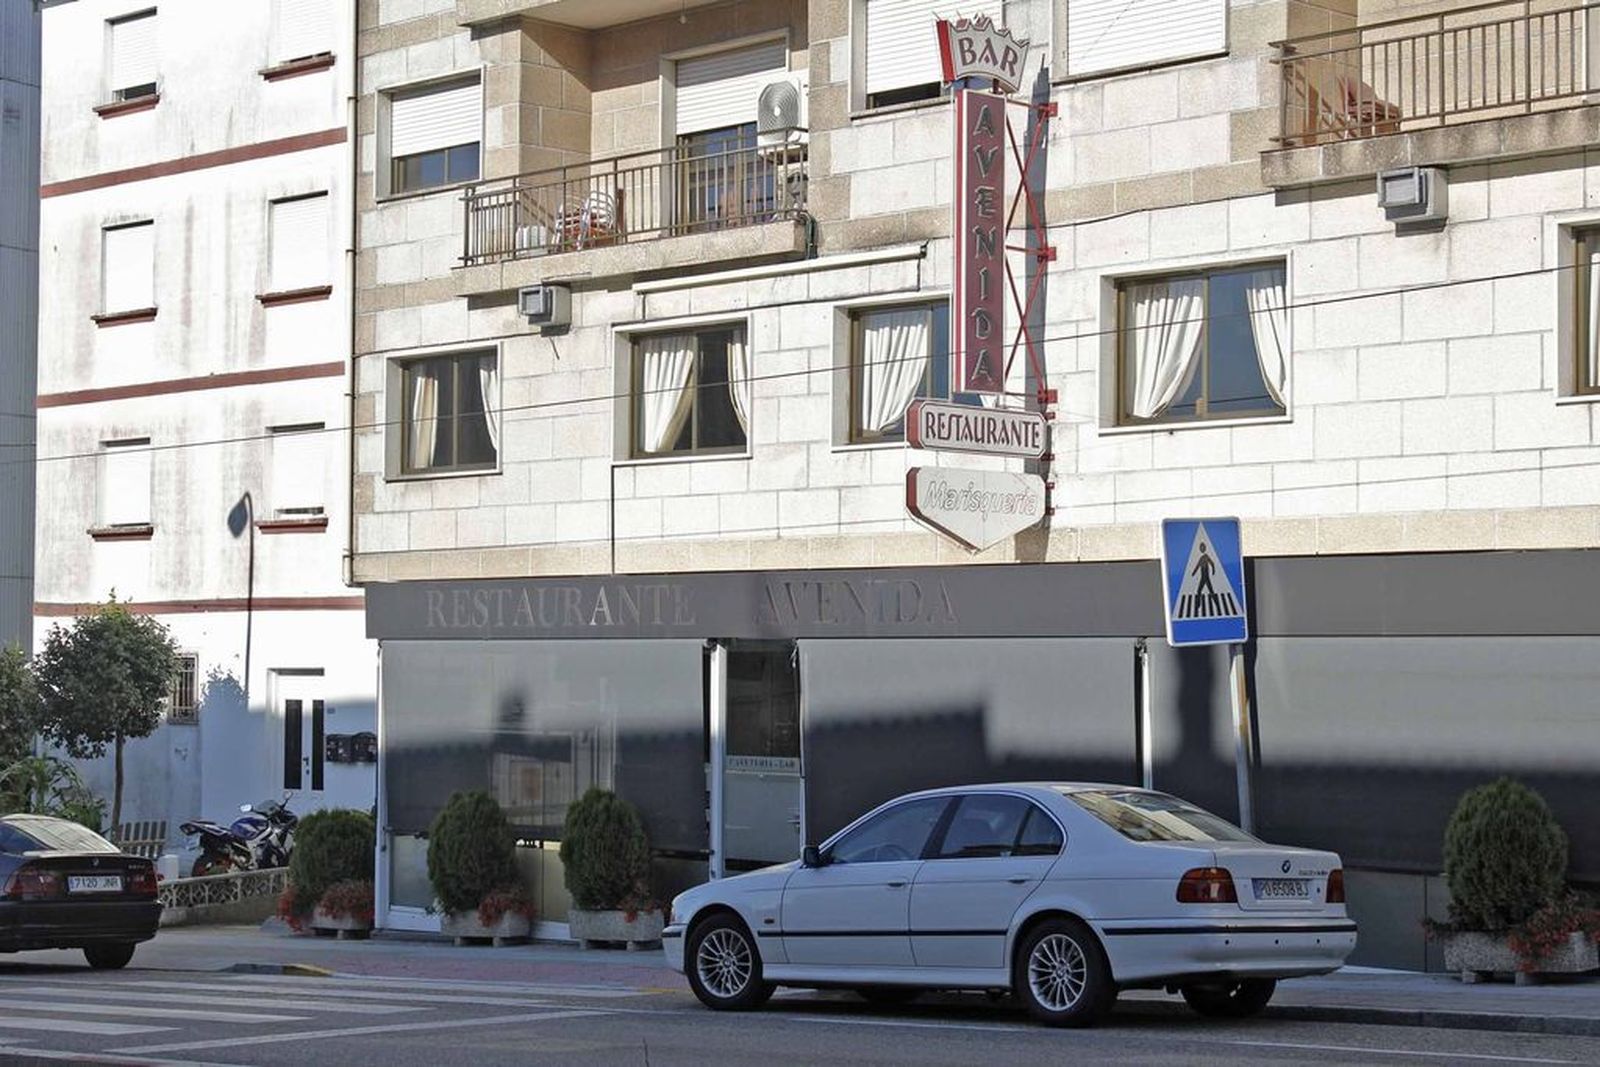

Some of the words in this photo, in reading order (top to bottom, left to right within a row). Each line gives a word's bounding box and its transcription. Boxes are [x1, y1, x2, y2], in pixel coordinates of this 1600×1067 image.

[957, 37, 1019, 77] BAR
[972, 104, 997, 386] AVENIDA
[925, 411, 1040, 448] RESTAURANTE
[426, 584, 696, 628] RESTAURANTE
[755, 578, 960, 625] AVENIDA
[74, 877, 98, 889] 7120
